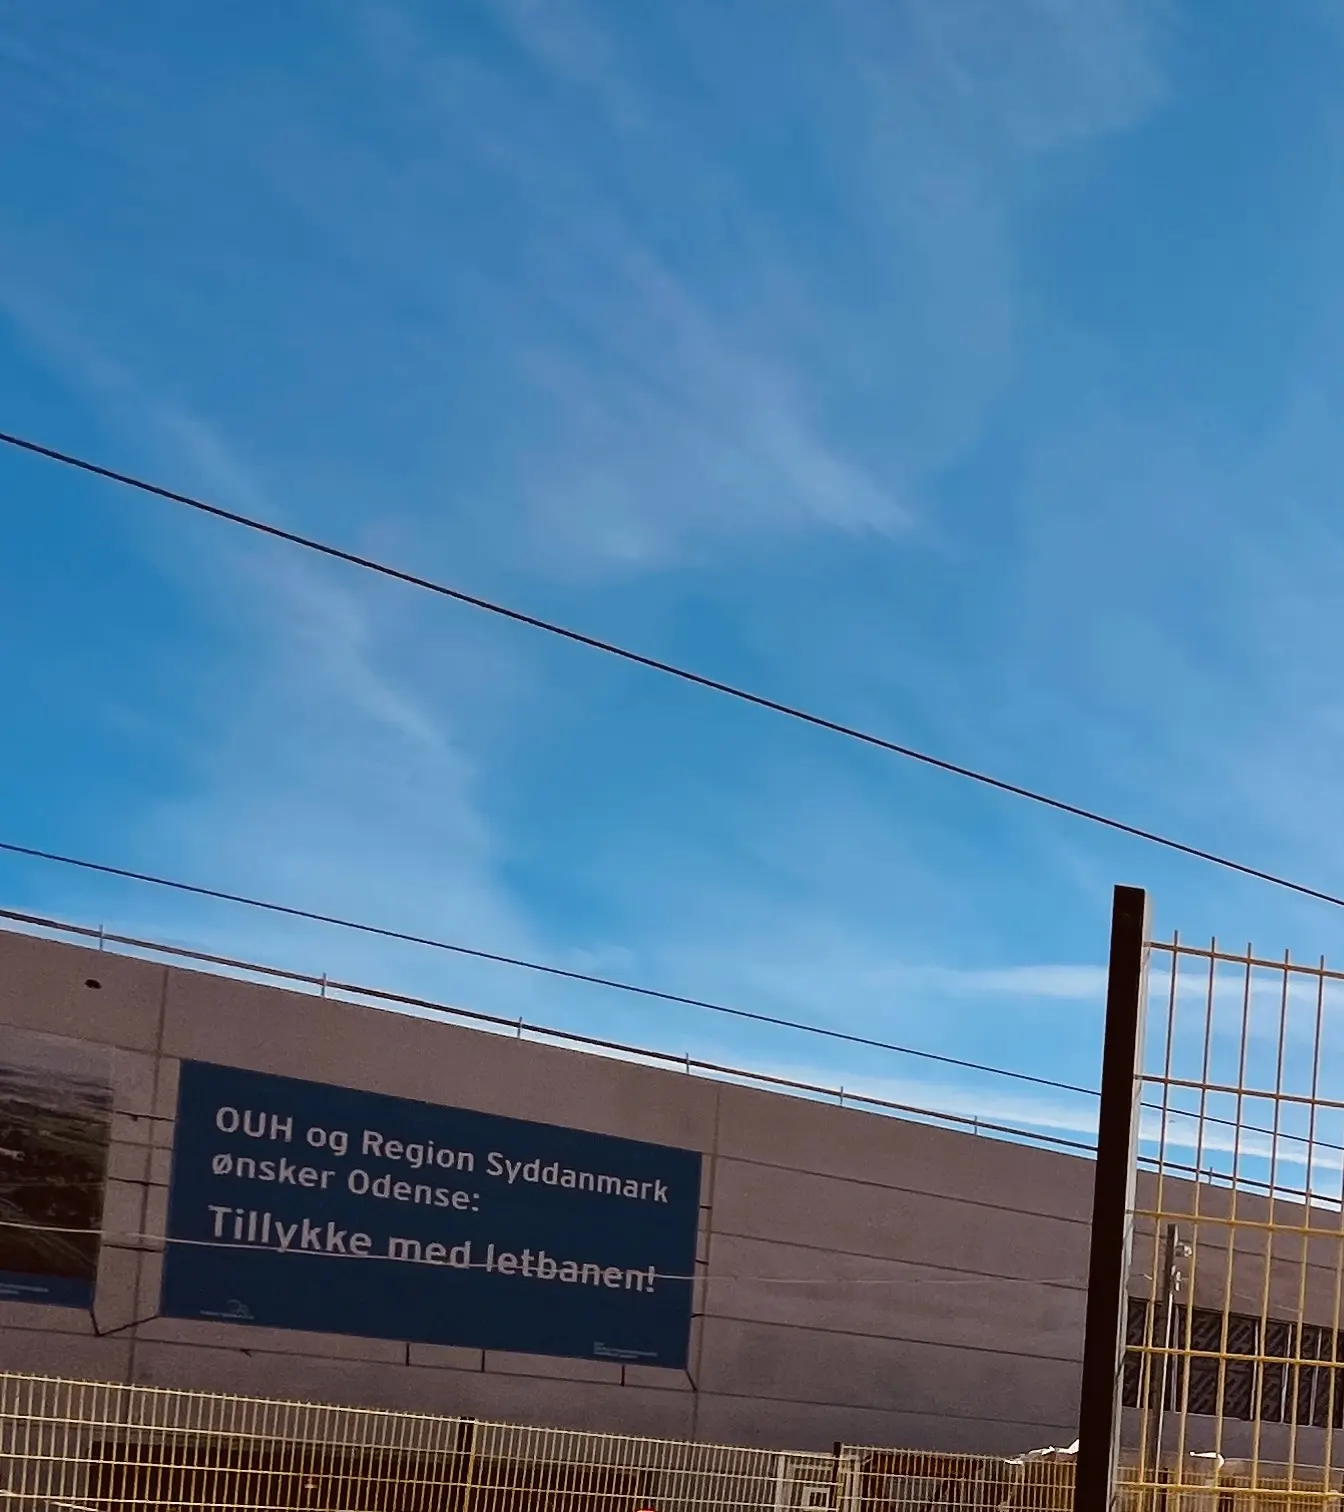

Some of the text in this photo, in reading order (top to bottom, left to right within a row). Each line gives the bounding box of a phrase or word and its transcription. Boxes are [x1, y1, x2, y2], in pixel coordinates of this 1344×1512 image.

[212, 1153, 480, 1212] ønsker Odense:
[215, 1106, 669, 1203] OUH og Region Syddanmark
[208, 1204, 656, 1293] Tillykke med letbanen!
